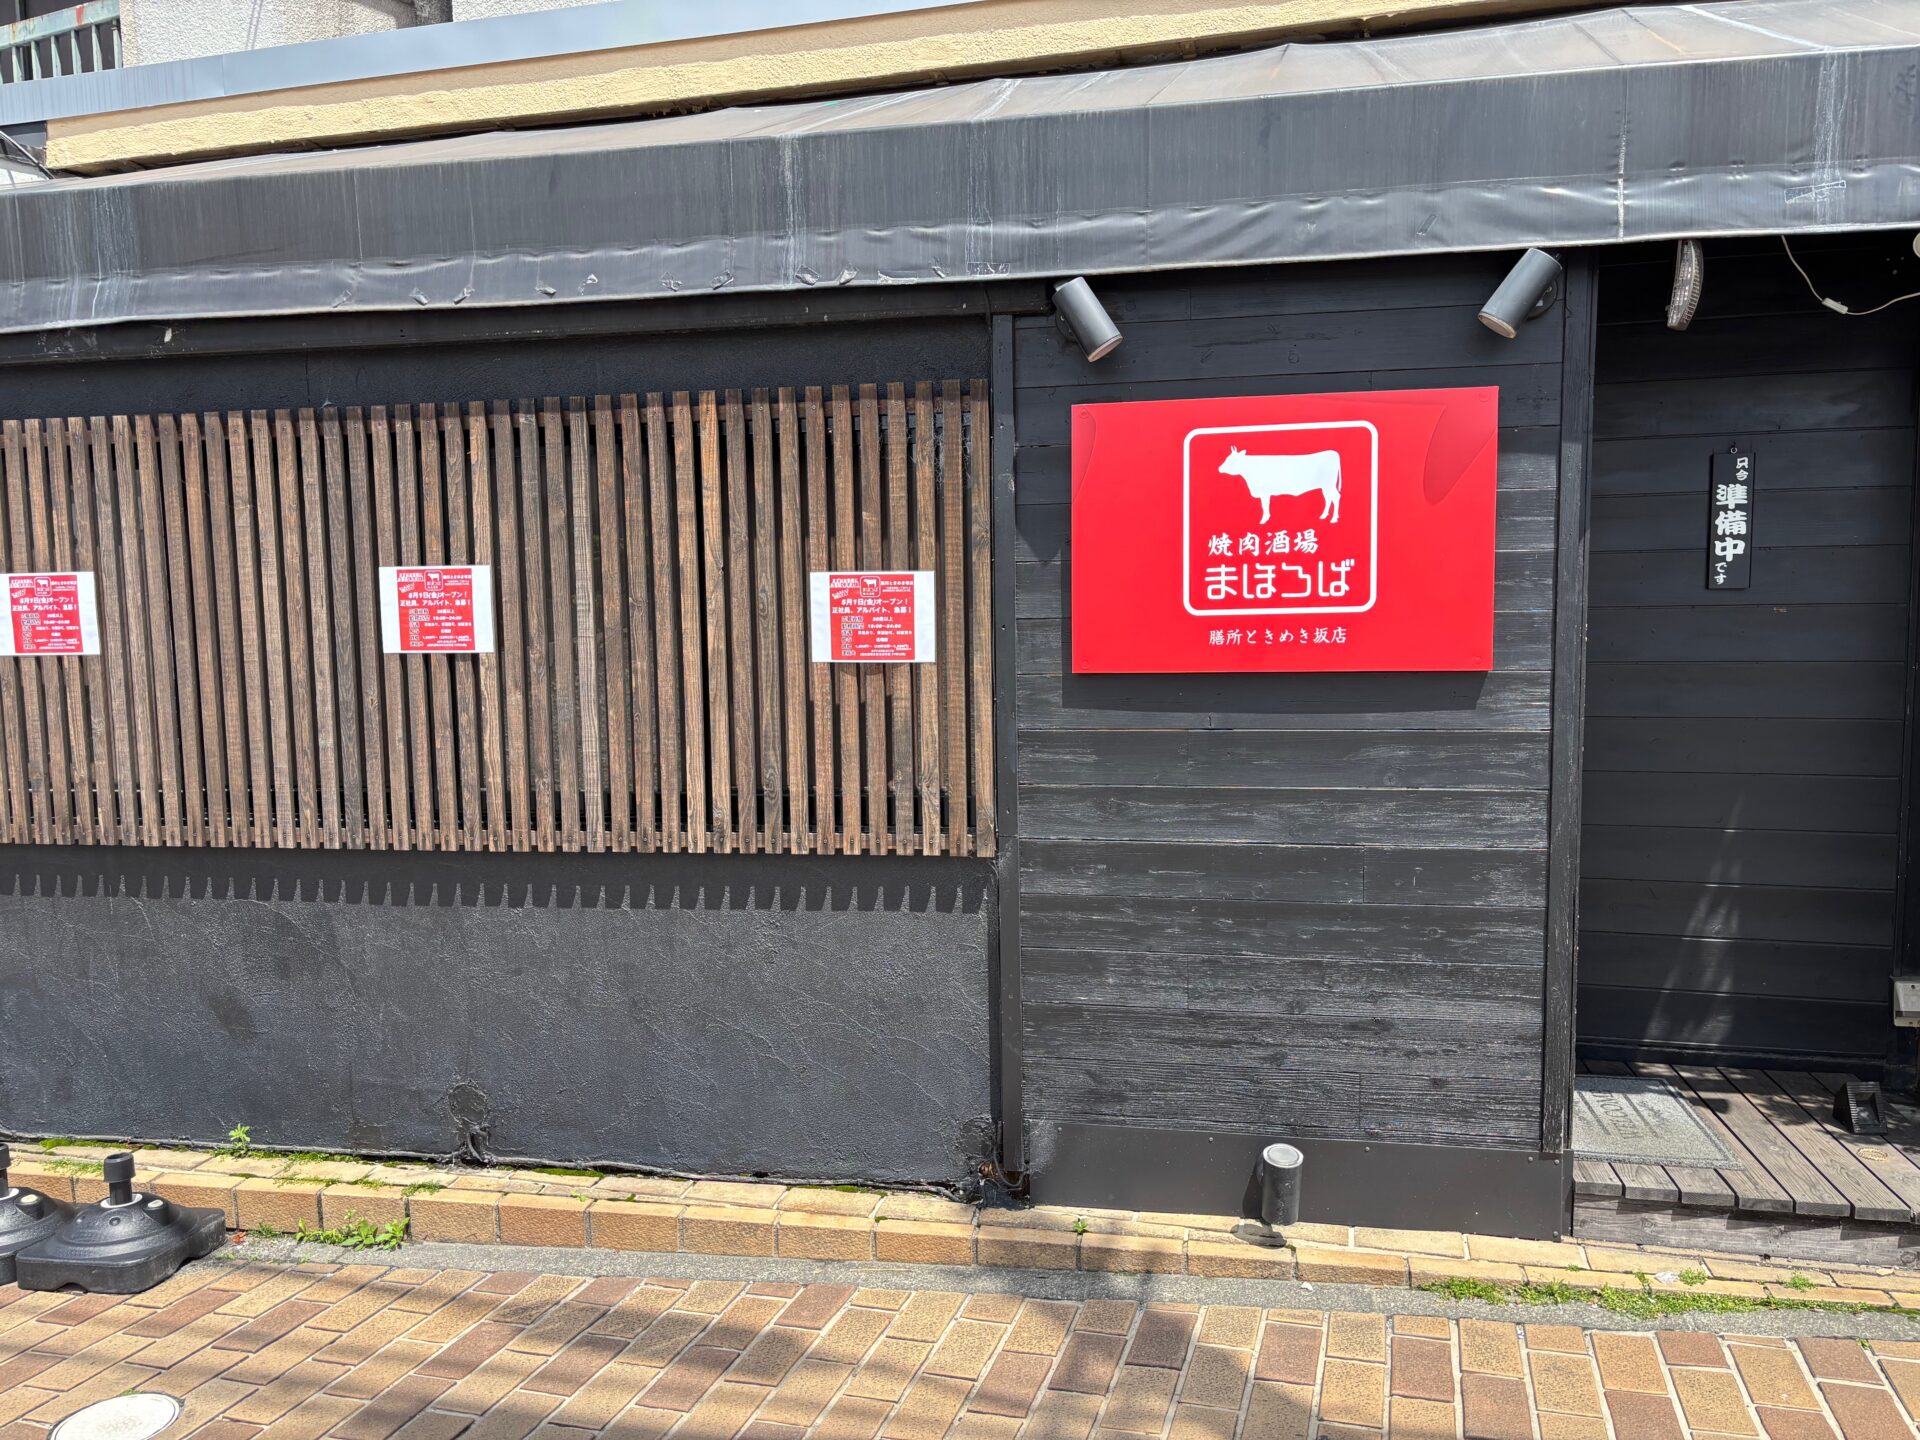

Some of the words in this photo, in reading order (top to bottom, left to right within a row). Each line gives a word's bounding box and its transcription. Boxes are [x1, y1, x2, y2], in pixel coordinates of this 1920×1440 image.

[1736, 457, 1749, 481] 只今
[1714, 484, 1748, 562] 準備中
[1207, 528, 1319, 557] 焼肉酒場
[1204, 558, 1355, 600] まほろば
[1714, 562, 1727, 585] です
[1209, 627, 1348, 646] 膳所ときめき坂店
[1590, 1088, 1644, 1139] WELCOM
